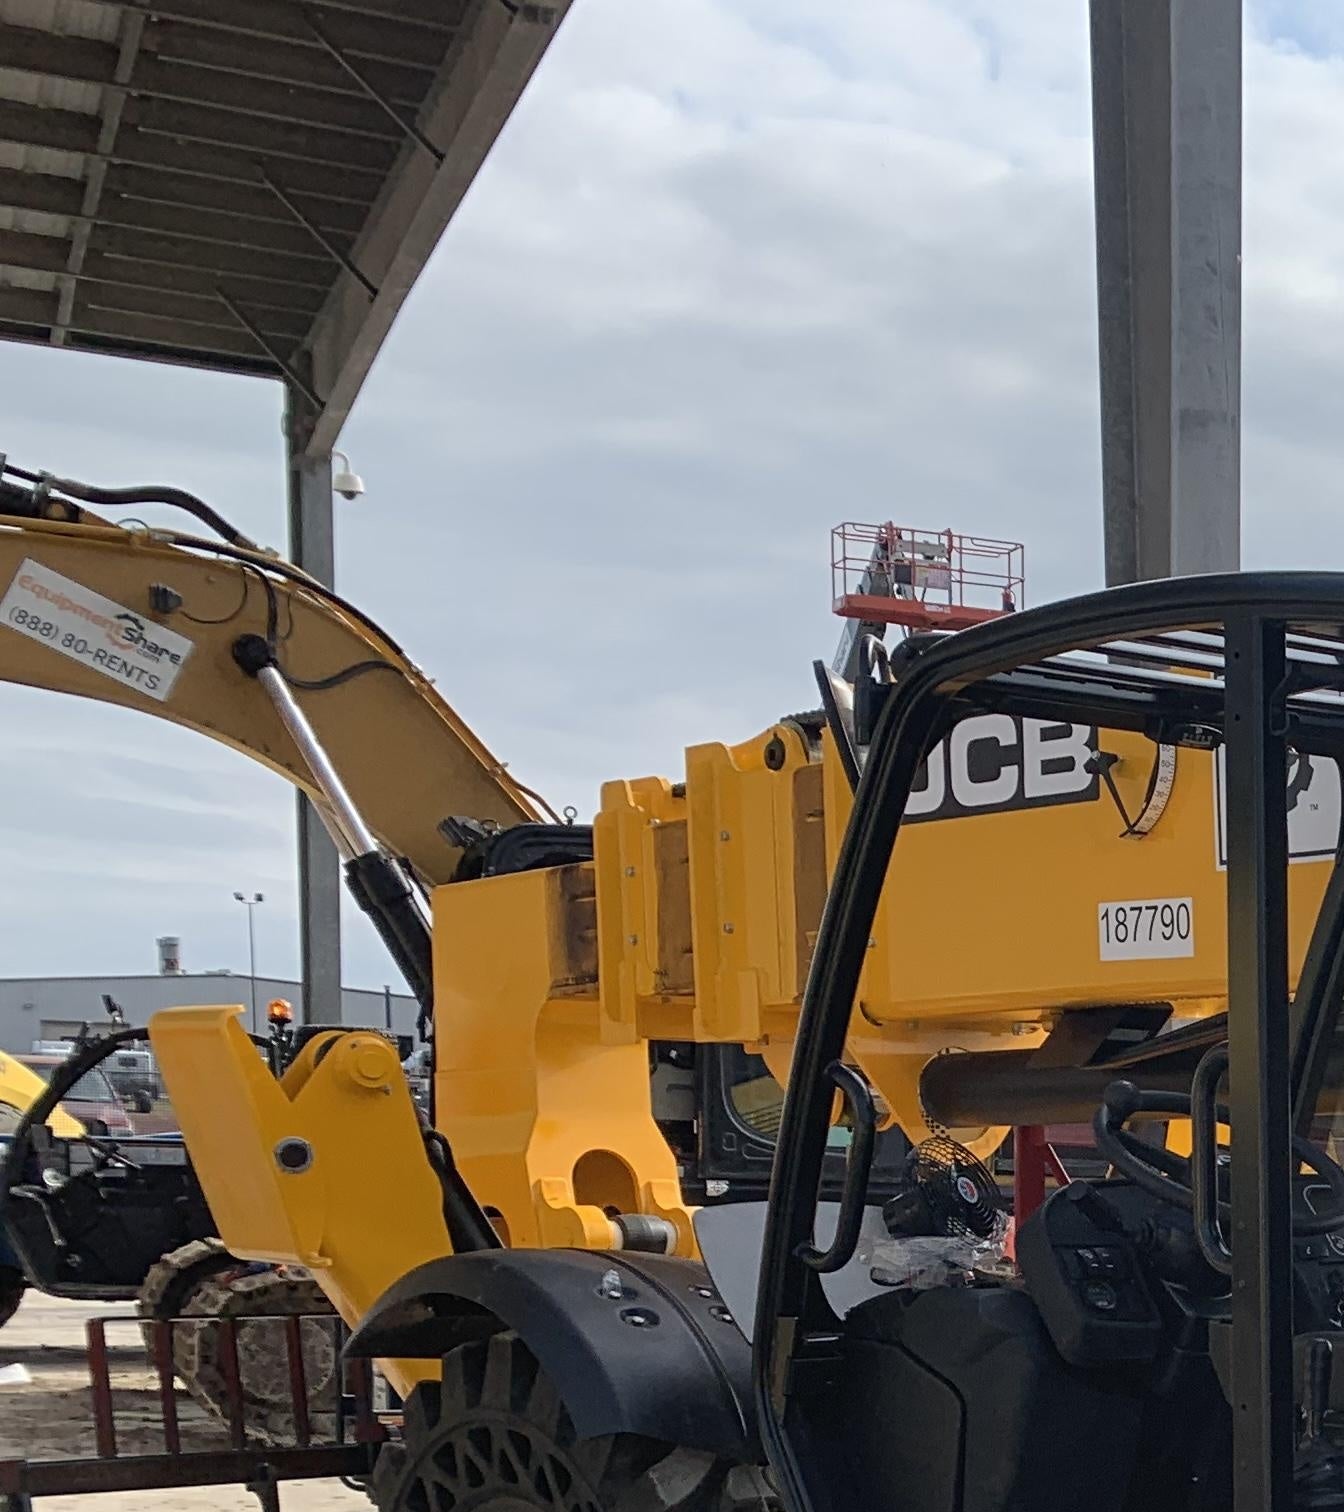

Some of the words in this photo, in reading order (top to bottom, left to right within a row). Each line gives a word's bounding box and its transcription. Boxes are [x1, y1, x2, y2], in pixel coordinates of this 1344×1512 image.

[8, 605, 60, 641] (888)
[61, 632, 161, 691] 80-RENTS
[1100, 902, 1191, 944] 187790
